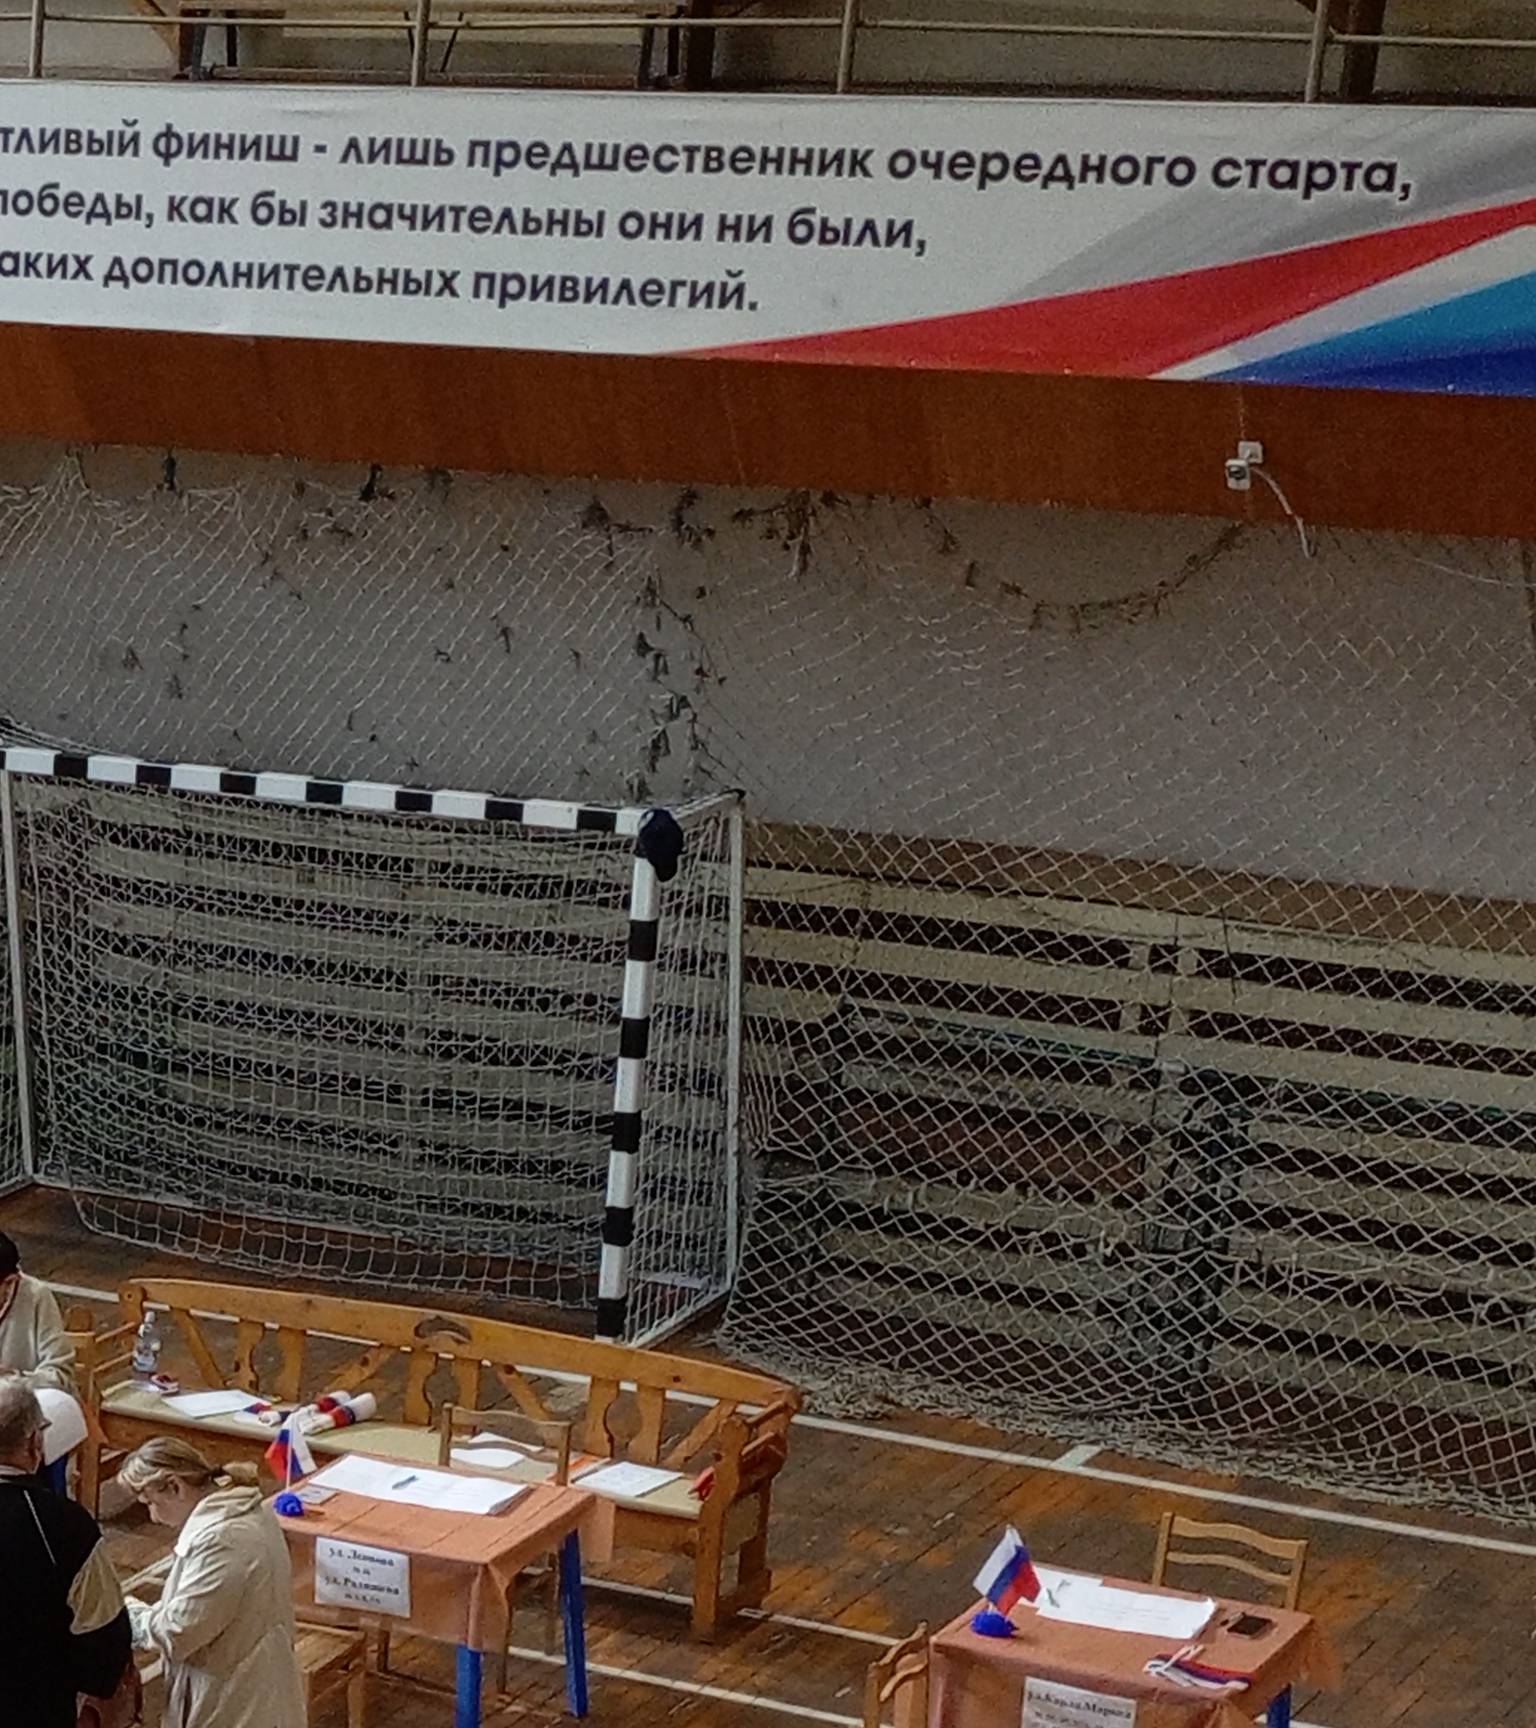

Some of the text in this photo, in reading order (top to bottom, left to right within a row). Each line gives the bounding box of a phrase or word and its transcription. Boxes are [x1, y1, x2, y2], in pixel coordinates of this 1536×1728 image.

[152, 122, 300, 168] финиш
[339, 136, 455, 167] лишь
[466, 139, 875, 179] предшественник
[887, 148, 1197, 191] очередного
[1211, 152, 1413, 202] старта,
[167, 195, 240, 225] как
[250, 189, 308, 227] бы
[318, 200, 606, 239] значительны
[618, 210, 704, 242] они
[716, 213, 774, 244] ни
[787, 206, 927, 257] были,
[102, 256, 461, 299] дополнительных
[472, 269, 758, 312] привилегий.
